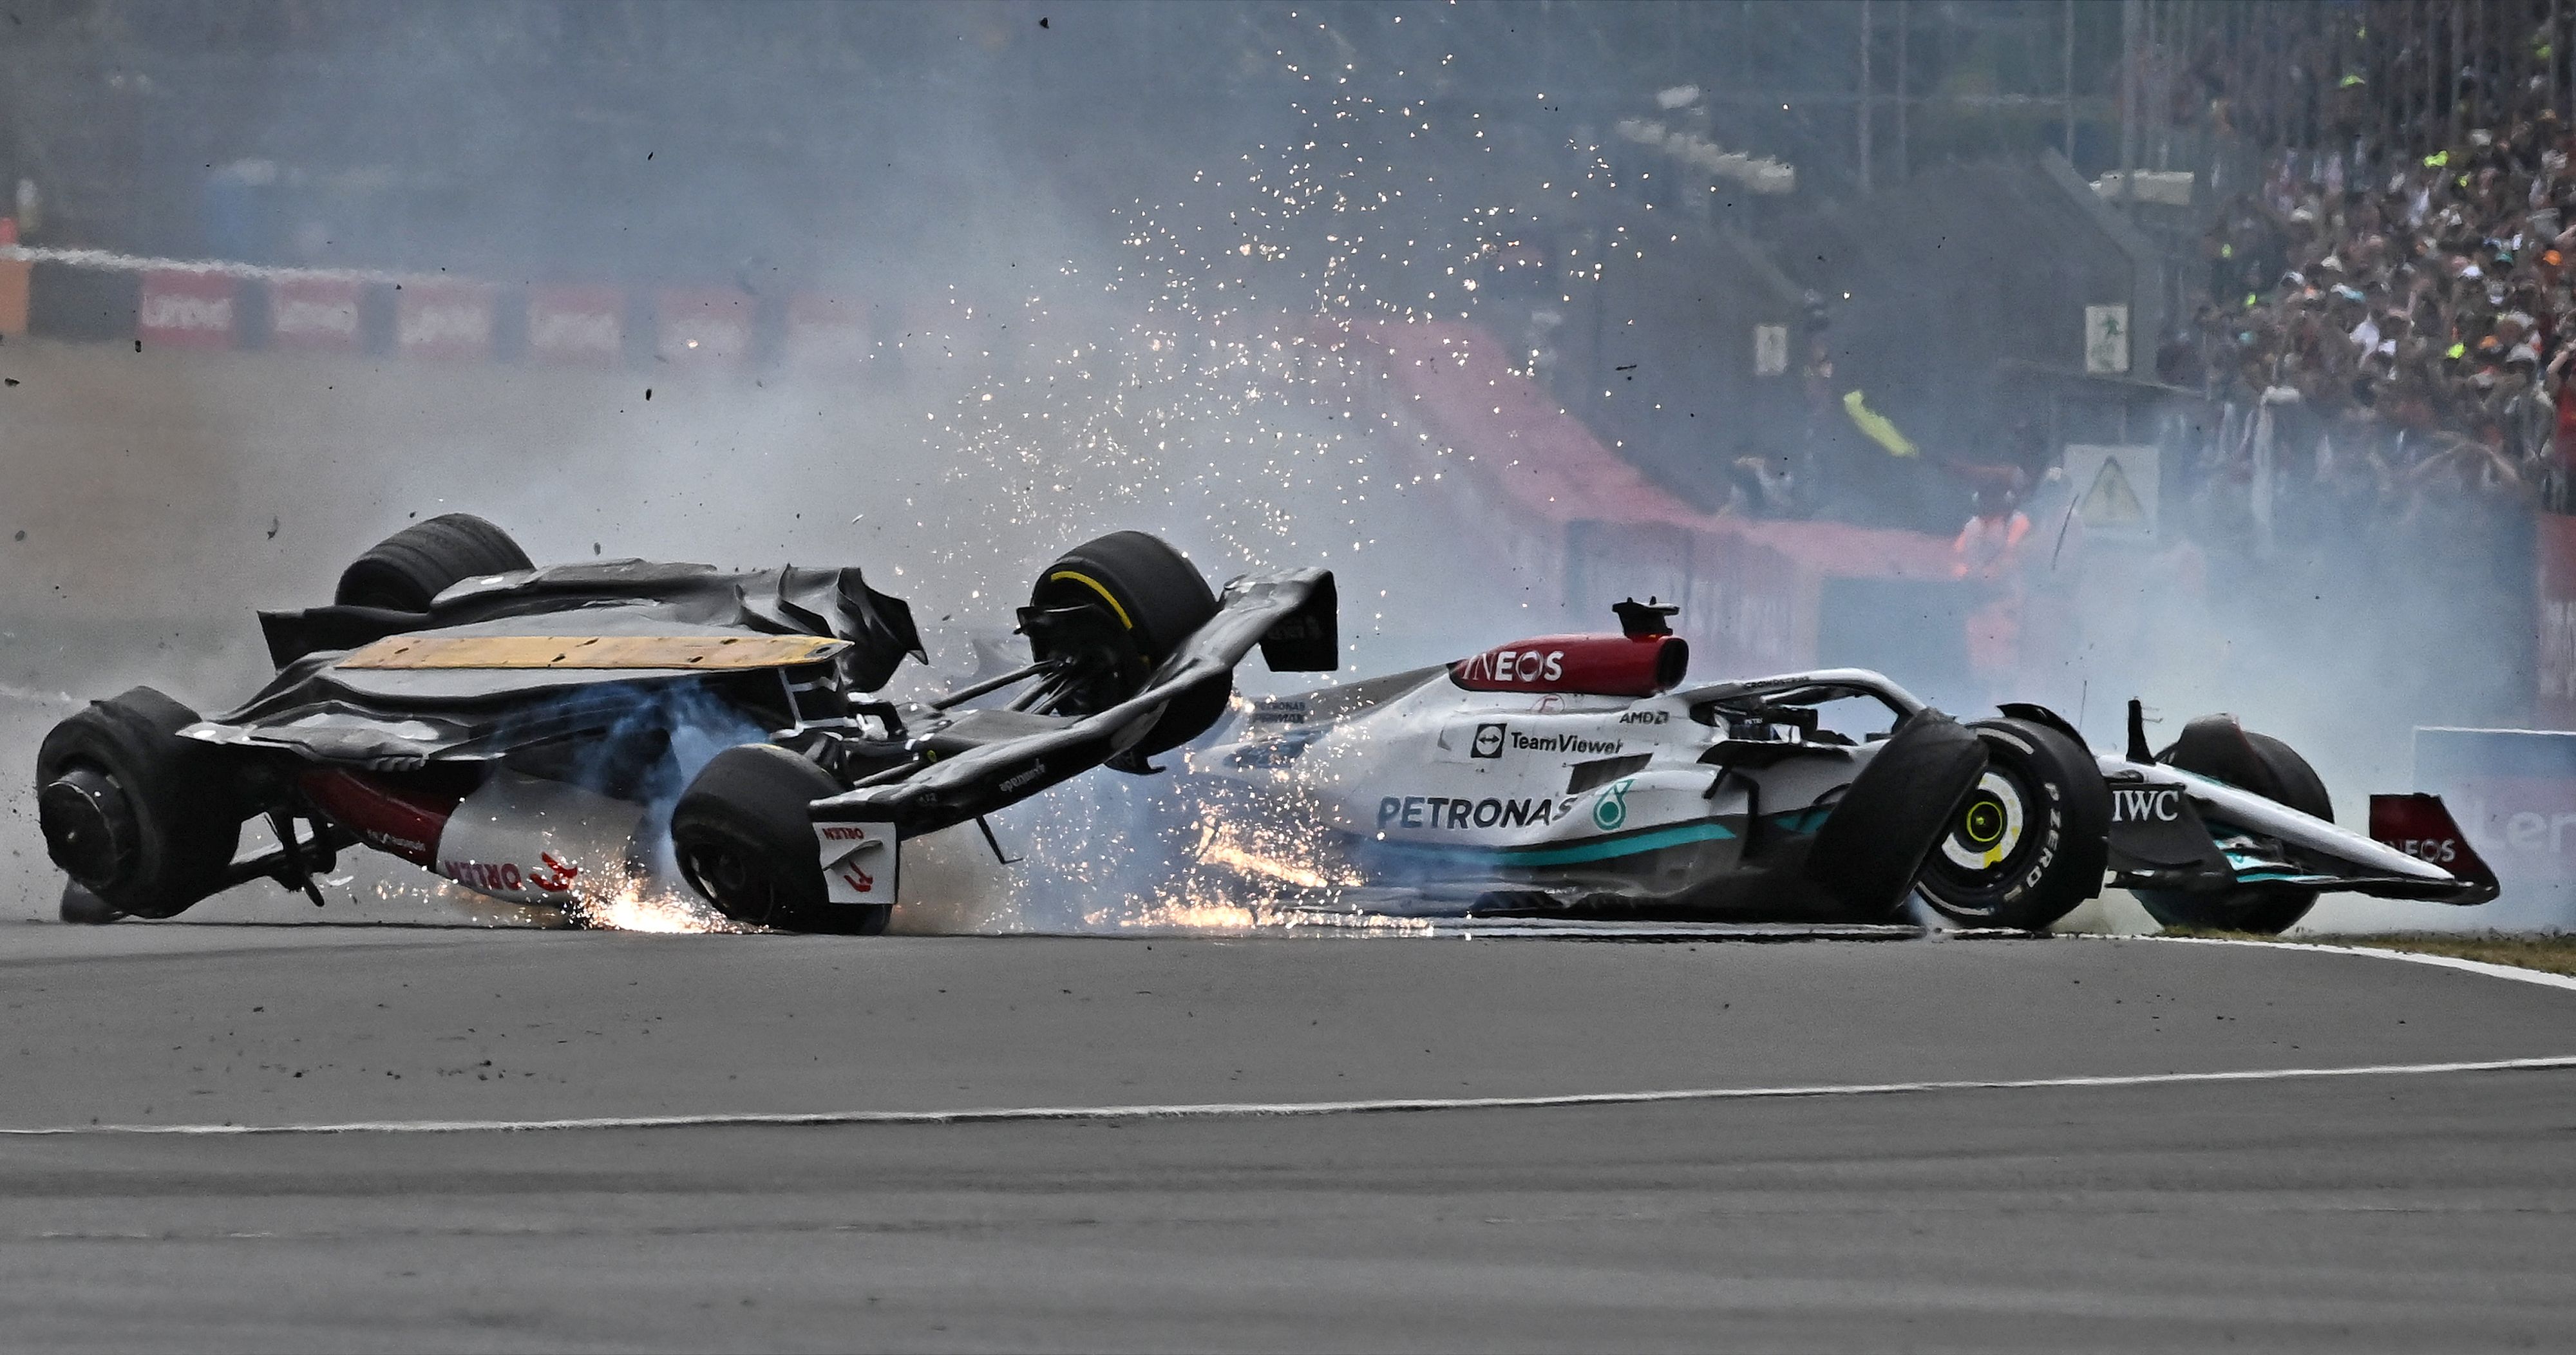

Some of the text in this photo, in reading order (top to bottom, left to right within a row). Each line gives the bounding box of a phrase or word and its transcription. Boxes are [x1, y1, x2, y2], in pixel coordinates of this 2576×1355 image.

[1461, 650, 1564, 682] INEOS
[1619, 710, 1654, 724] AMD
[1511, 732, 1623, 755] TeamViewer
[1377, 796, 1578, 829] PETRONAS
[2112, 790, 2179, 821] IWC
[2027, 808, 2061, 888] ZERO
[444, 860, 522, 891] ORLEN
